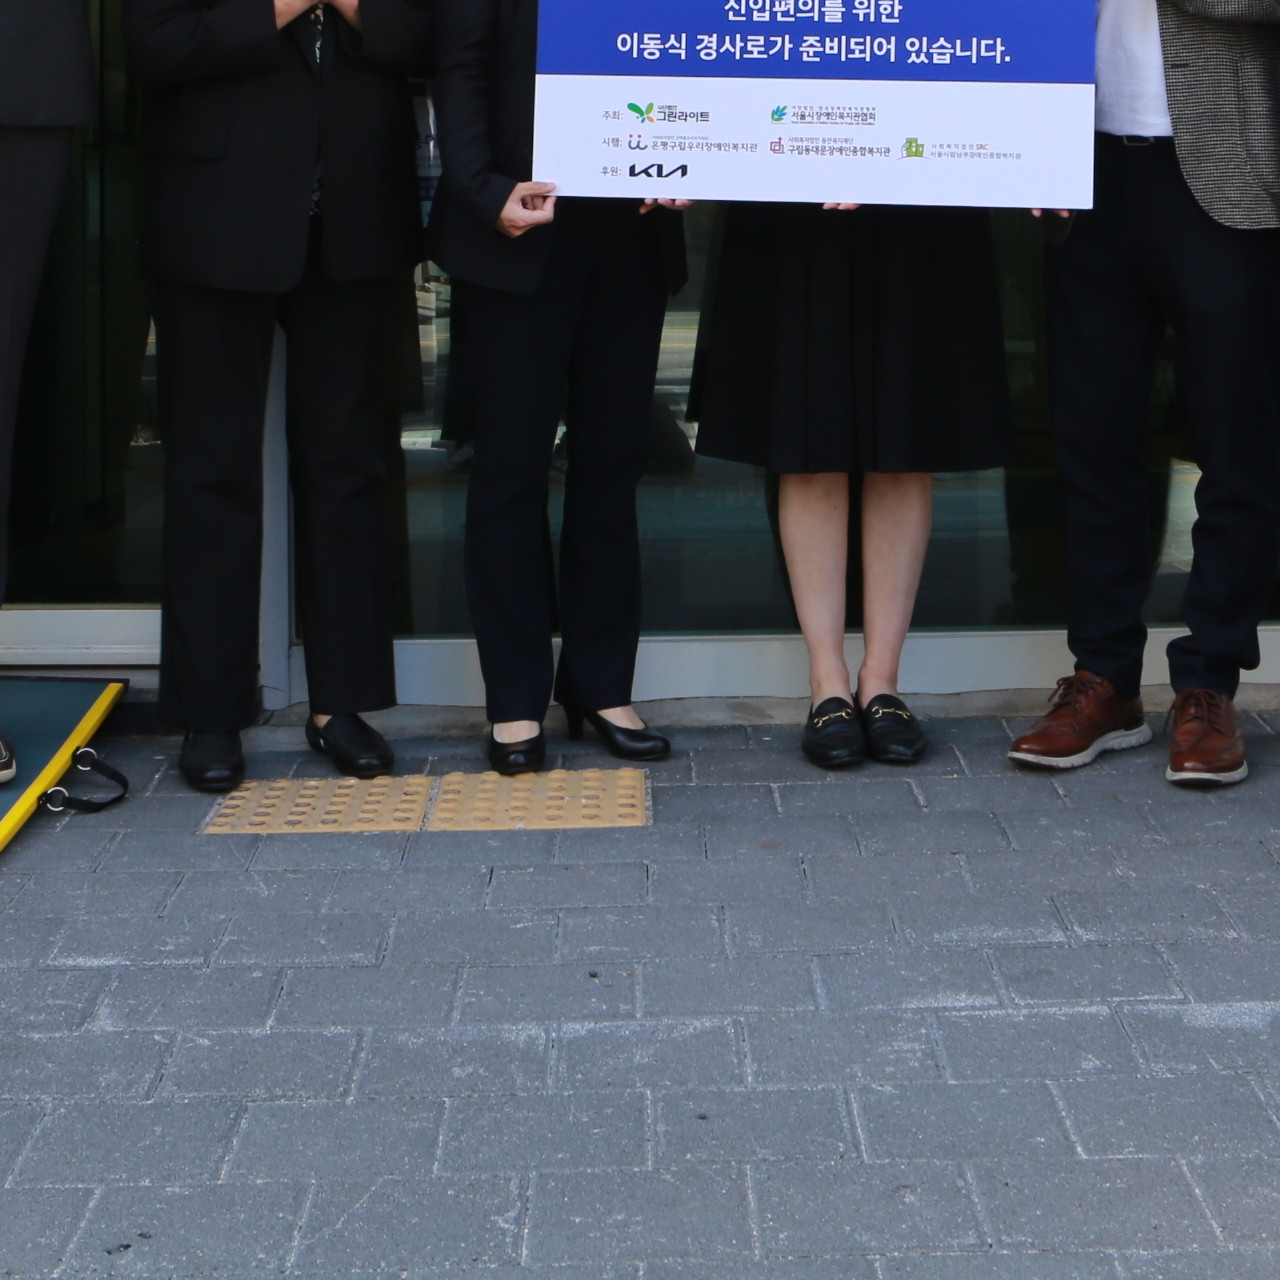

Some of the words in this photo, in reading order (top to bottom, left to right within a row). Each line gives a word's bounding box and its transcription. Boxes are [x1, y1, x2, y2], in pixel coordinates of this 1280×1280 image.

[616, 32, 686, 61] 이동식
[695, 33, 793, 62] 경사로가
[799, 34, 897, 64] 준비되어
[904, 36, 1011, 65] 있습니다.
[602, 110, 624, 121] 주최:
[656, 110, 710, 123] 그린라이트
[601, 137, 623, 148] 시행:
[651, 140, 759, 153] 은평구립우리장애인복지관
[788, 145, 892, 157] 구립동대문장애인종합복지관
[975, 143, 989, 151] SRC
[600, 166, 622, 177] 후원:
